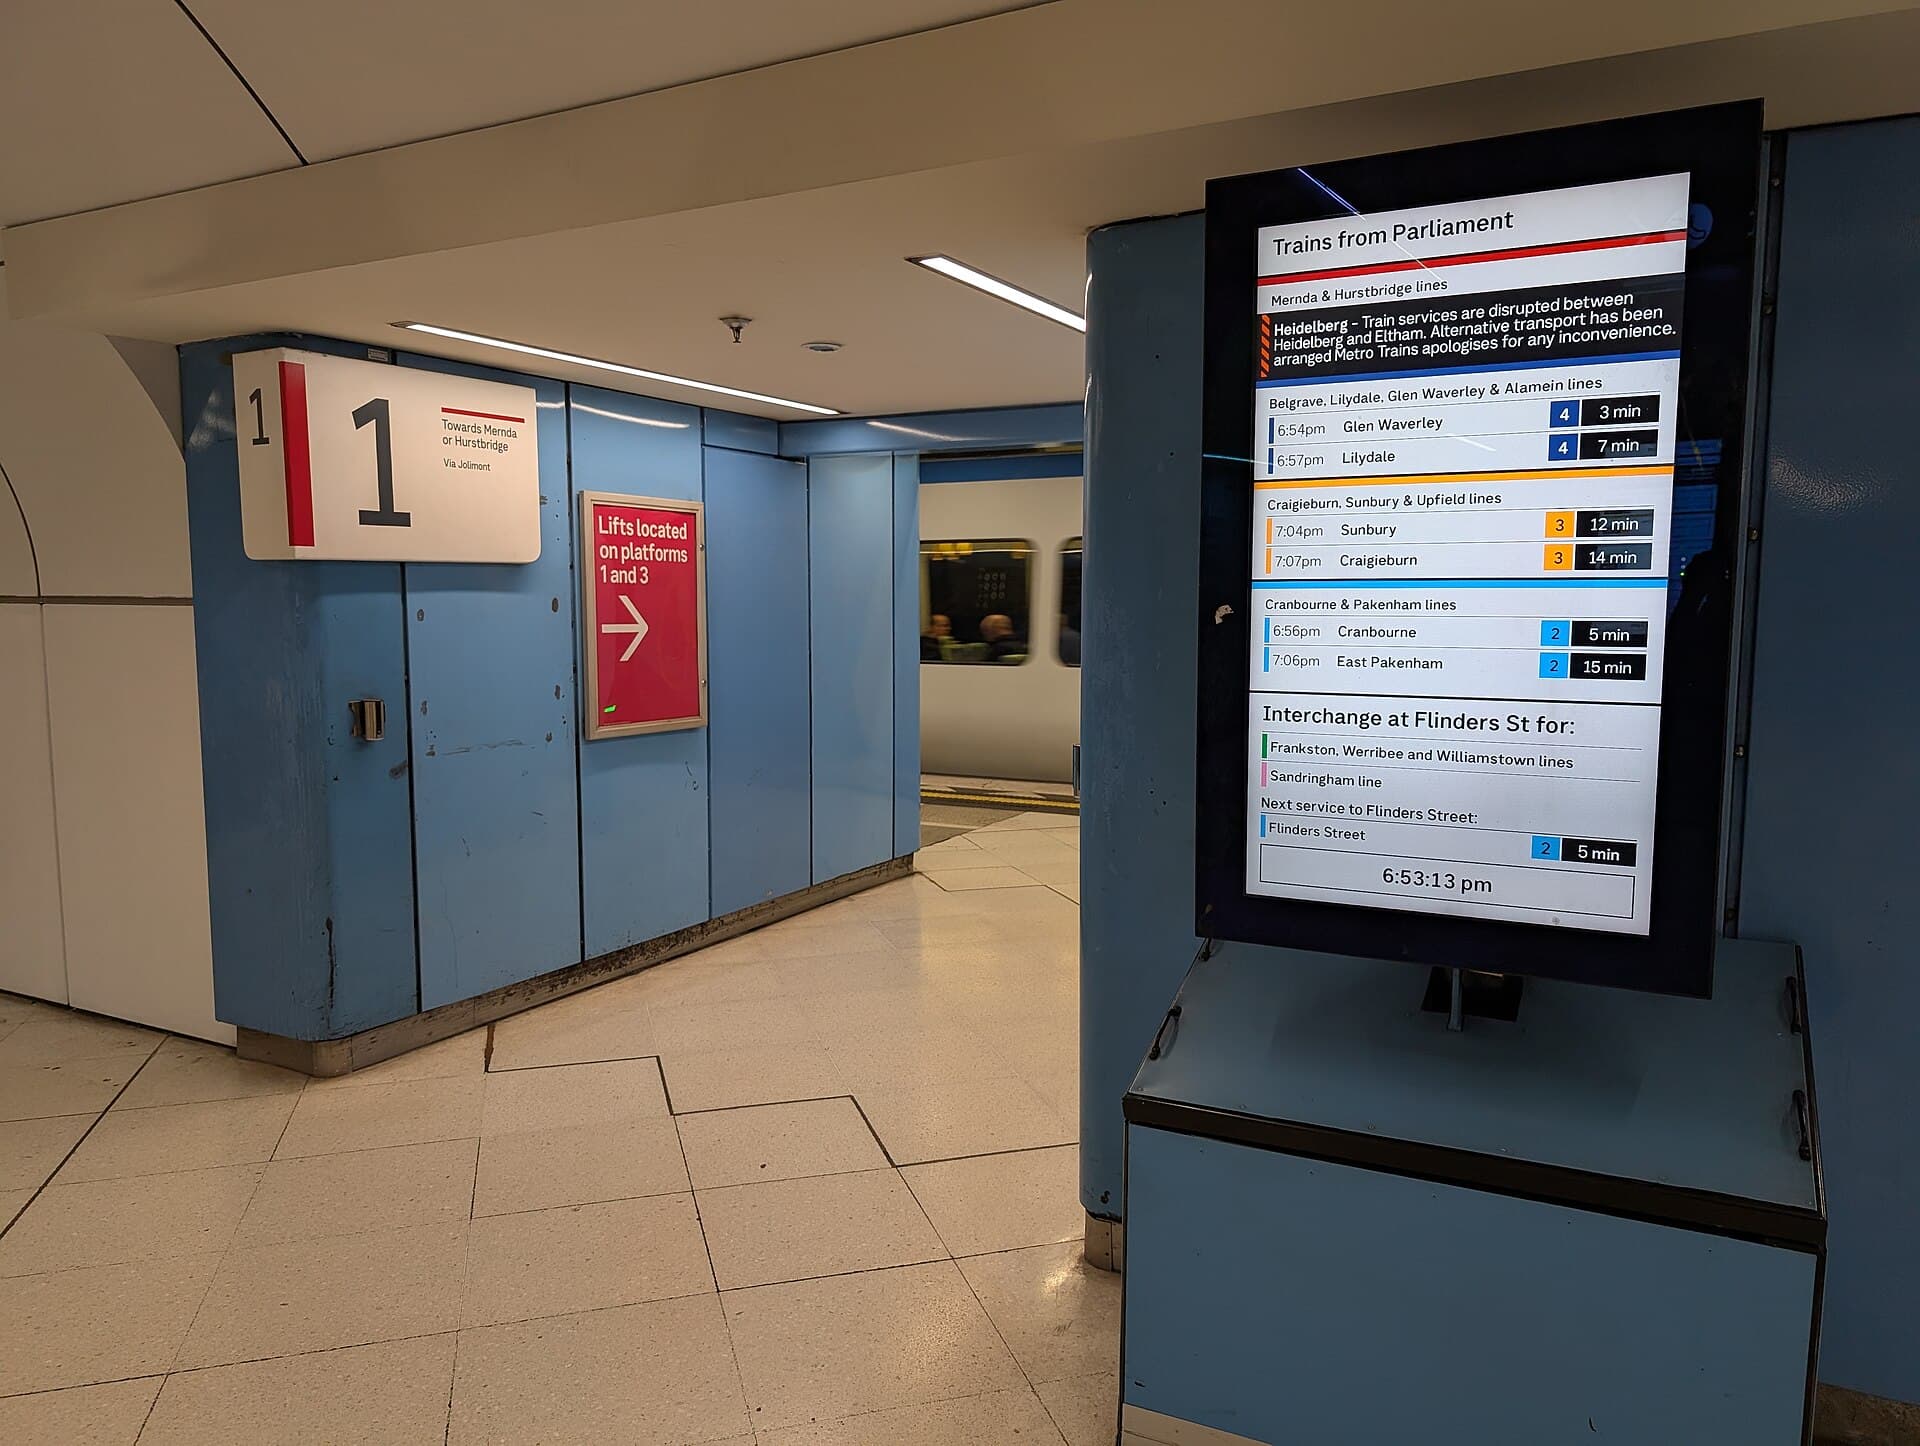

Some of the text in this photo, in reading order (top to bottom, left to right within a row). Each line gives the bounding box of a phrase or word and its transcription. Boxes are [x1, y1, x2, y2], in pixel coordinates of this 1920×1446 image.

[1273, 211, 1514, 256] Trains from Parliament
[1271, 279, 1448, 307] Mernda & Hurstbridge lines
[1274, 318, 1348, 338] Heidelberg
[1362, 314, 1395, 329] Train
[1398, 308, 1458, 326] services
[1461, 307, 1485, 319] are
[1489, 298, 1560, 319] disrupted
[1564, 292, 1634, 311] between
[1274, 306, 1663, 352] Heidelberg and Eltham. Alternative transport has been
[1273, 322, 1676, 368] arranged Metro Trains apologises for any inconvenience.
[1388, 388, 1418, 403] Glen
[1422, 384, 1485, 402] Waverley
[1489, 382, 1500, 395] &
[1504, 379, 1564, 394] Alamein
[1568, 377, 1602, 391] lines
[249, 388, 270, 445] 1
[1560, 408, 1569, 421] 4
[1600, 403, 1641, 418] 3 min
[442, 419, 517, 438] Towards Mernda
[1278, 415, 1443, 439] 6:54pm Glen Waverley
[442, 435, 508, 453] or Hurstbridge
[1558, 441, 1568, 454] 4
[1599, 438, 1639, 452] 7 min
[352, 398, 411, 527] 1
[444, 458, 490, 472] Via Jolimont
[1278, 449, 1395, 470] 6:57pm Lilydale
[1345, 494, 1399, 512] Sunbury
[1403, 495, 1412, 507] &
[1417, 491, 1465, 509] Upfield
[1469, 490, 1502, 505] lines
[598, 516, 687, 540] Lifts located
[1275, 522, 1397, 541] 7:04pm Sunbury
[1555, 519, 1564, 532] 3
[1590, 516, 1639, 531] 12 min
[600, 542, 688, 564] on platforms
[1275, 552, 1418, 573] 7:07pm Craigieburn
[1554, 551, 1563, 565] 3
[1589, 550, 1637, 565] 14 min
[600, 565, 648, 584] 1 and 3
[1265, 597, 1457, 611] Cranbourne & Pakenham lines
[1273, 625, 1417, 640] 6:56pm Cranbourne
[1551, 627, 1560, 640] 2
[1589, 627, 1630, 642] 5 min
[1272, 654, 1443, 671] 7:06pm East Pakenham
[1550, 660, 1558, 672] 2
[1583, 660, 1632, 674] 15 min
[1263, 706, 1576, 735] Interchange at Flinders St for:
[1270, 741, 1574, 769] Frankston, Werribee and Williamstown lines
[1270, 770, 1382, 788] Sandringham line
[1261, 797, 1478, 824] Next service to Flinders Street:
[1269, 821, 1366, 842] Flinders Street
[1540, 842, 1551, 856] 2
[1577, 845, 1620, 862] 5 min
[1382, 867, 1493, 895] 6:53:13 pm
